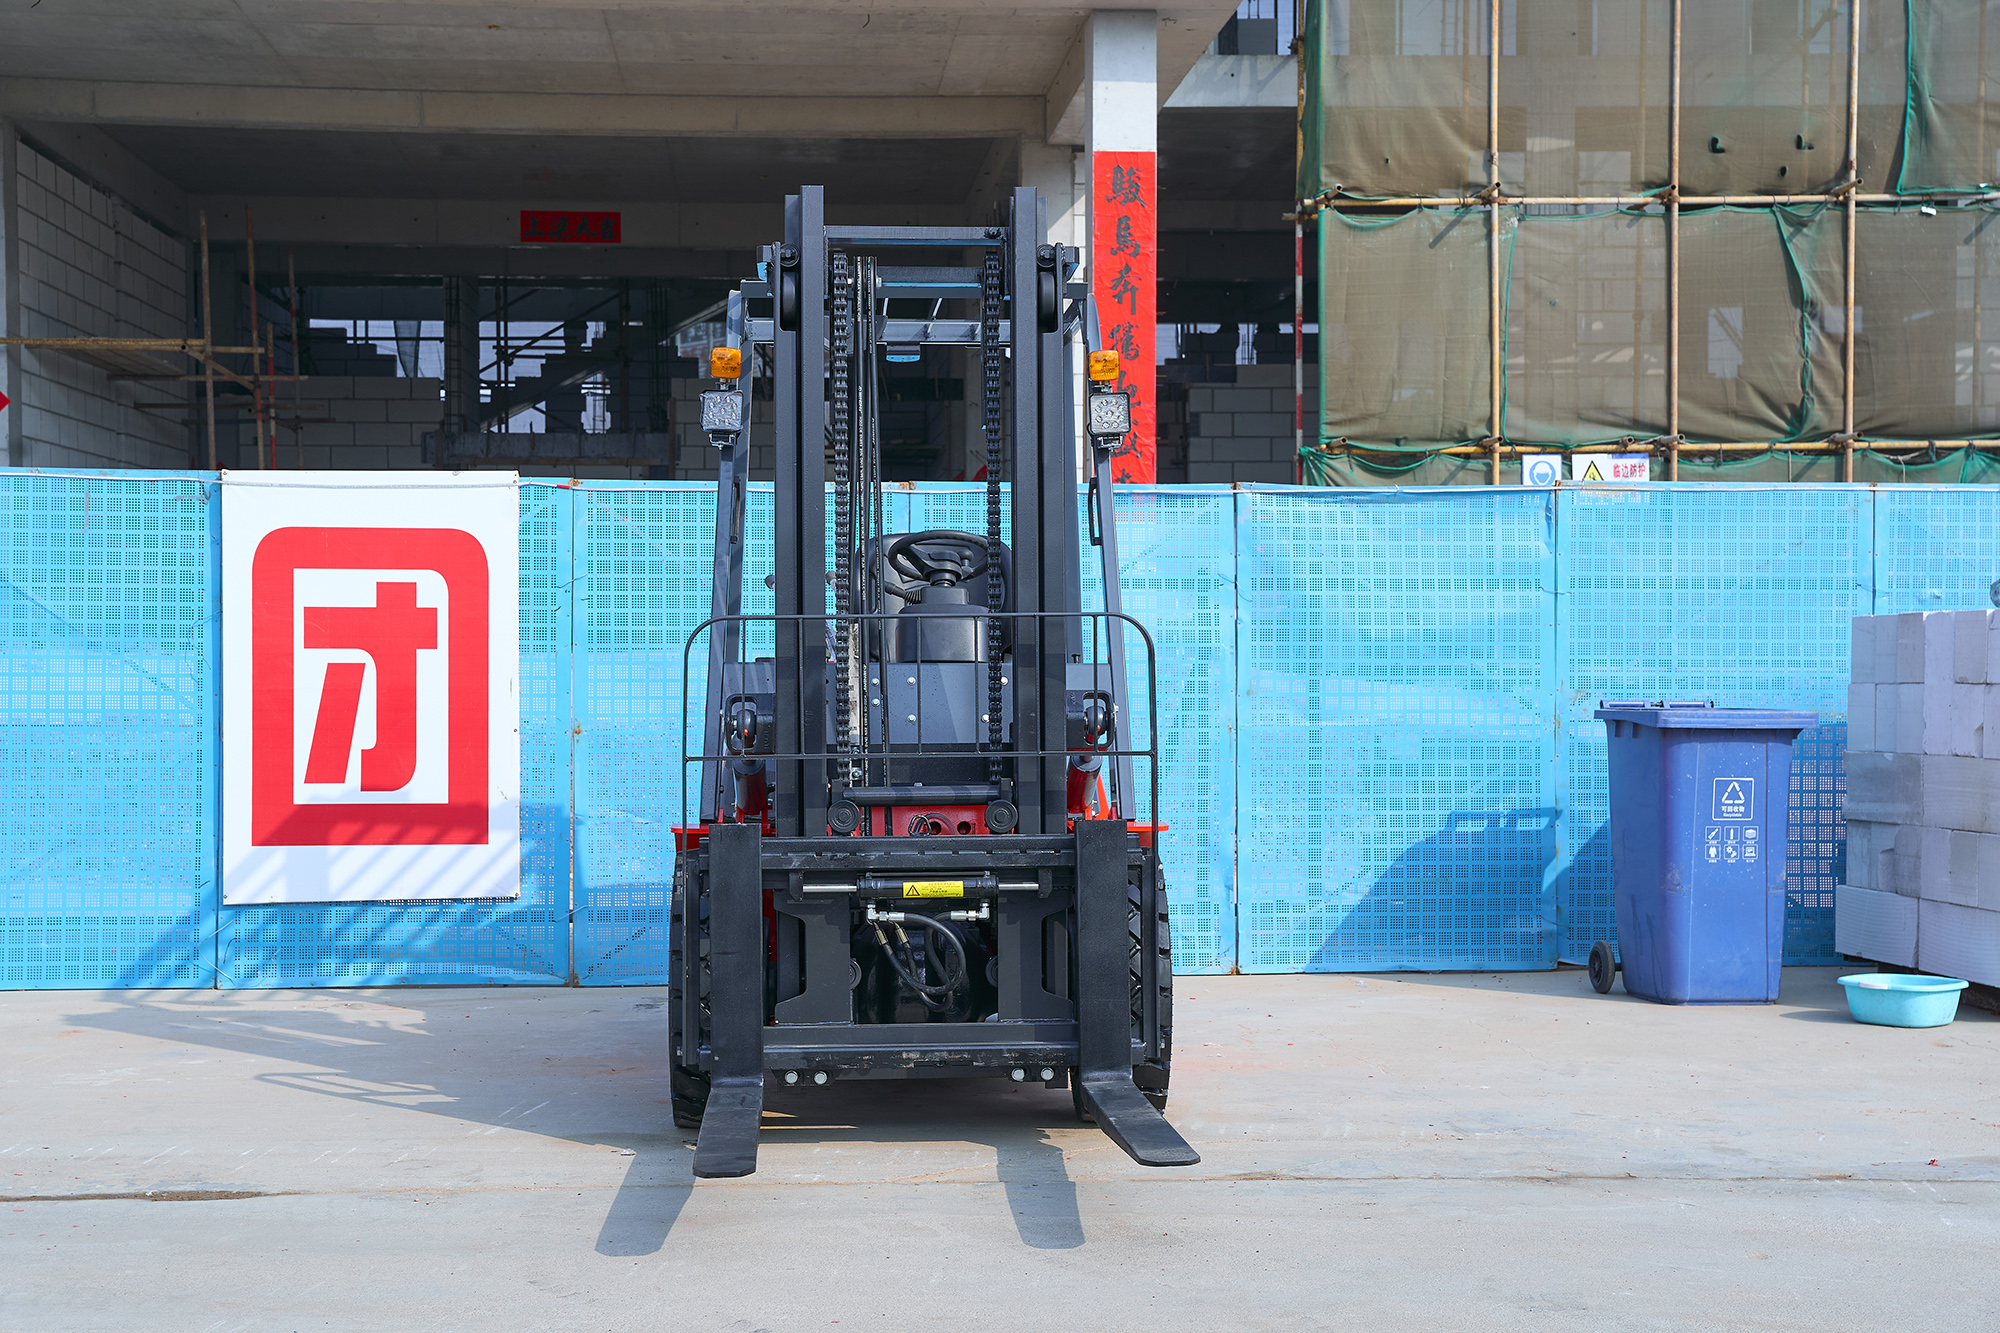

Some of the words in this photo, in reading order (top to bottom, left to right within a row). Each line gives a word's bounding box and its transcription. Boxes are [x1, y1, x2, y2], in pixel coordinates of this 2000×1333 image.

[523, 215, 616, 241] 上梁大吉
[1613, 463, 1646, 478] 临边防护
